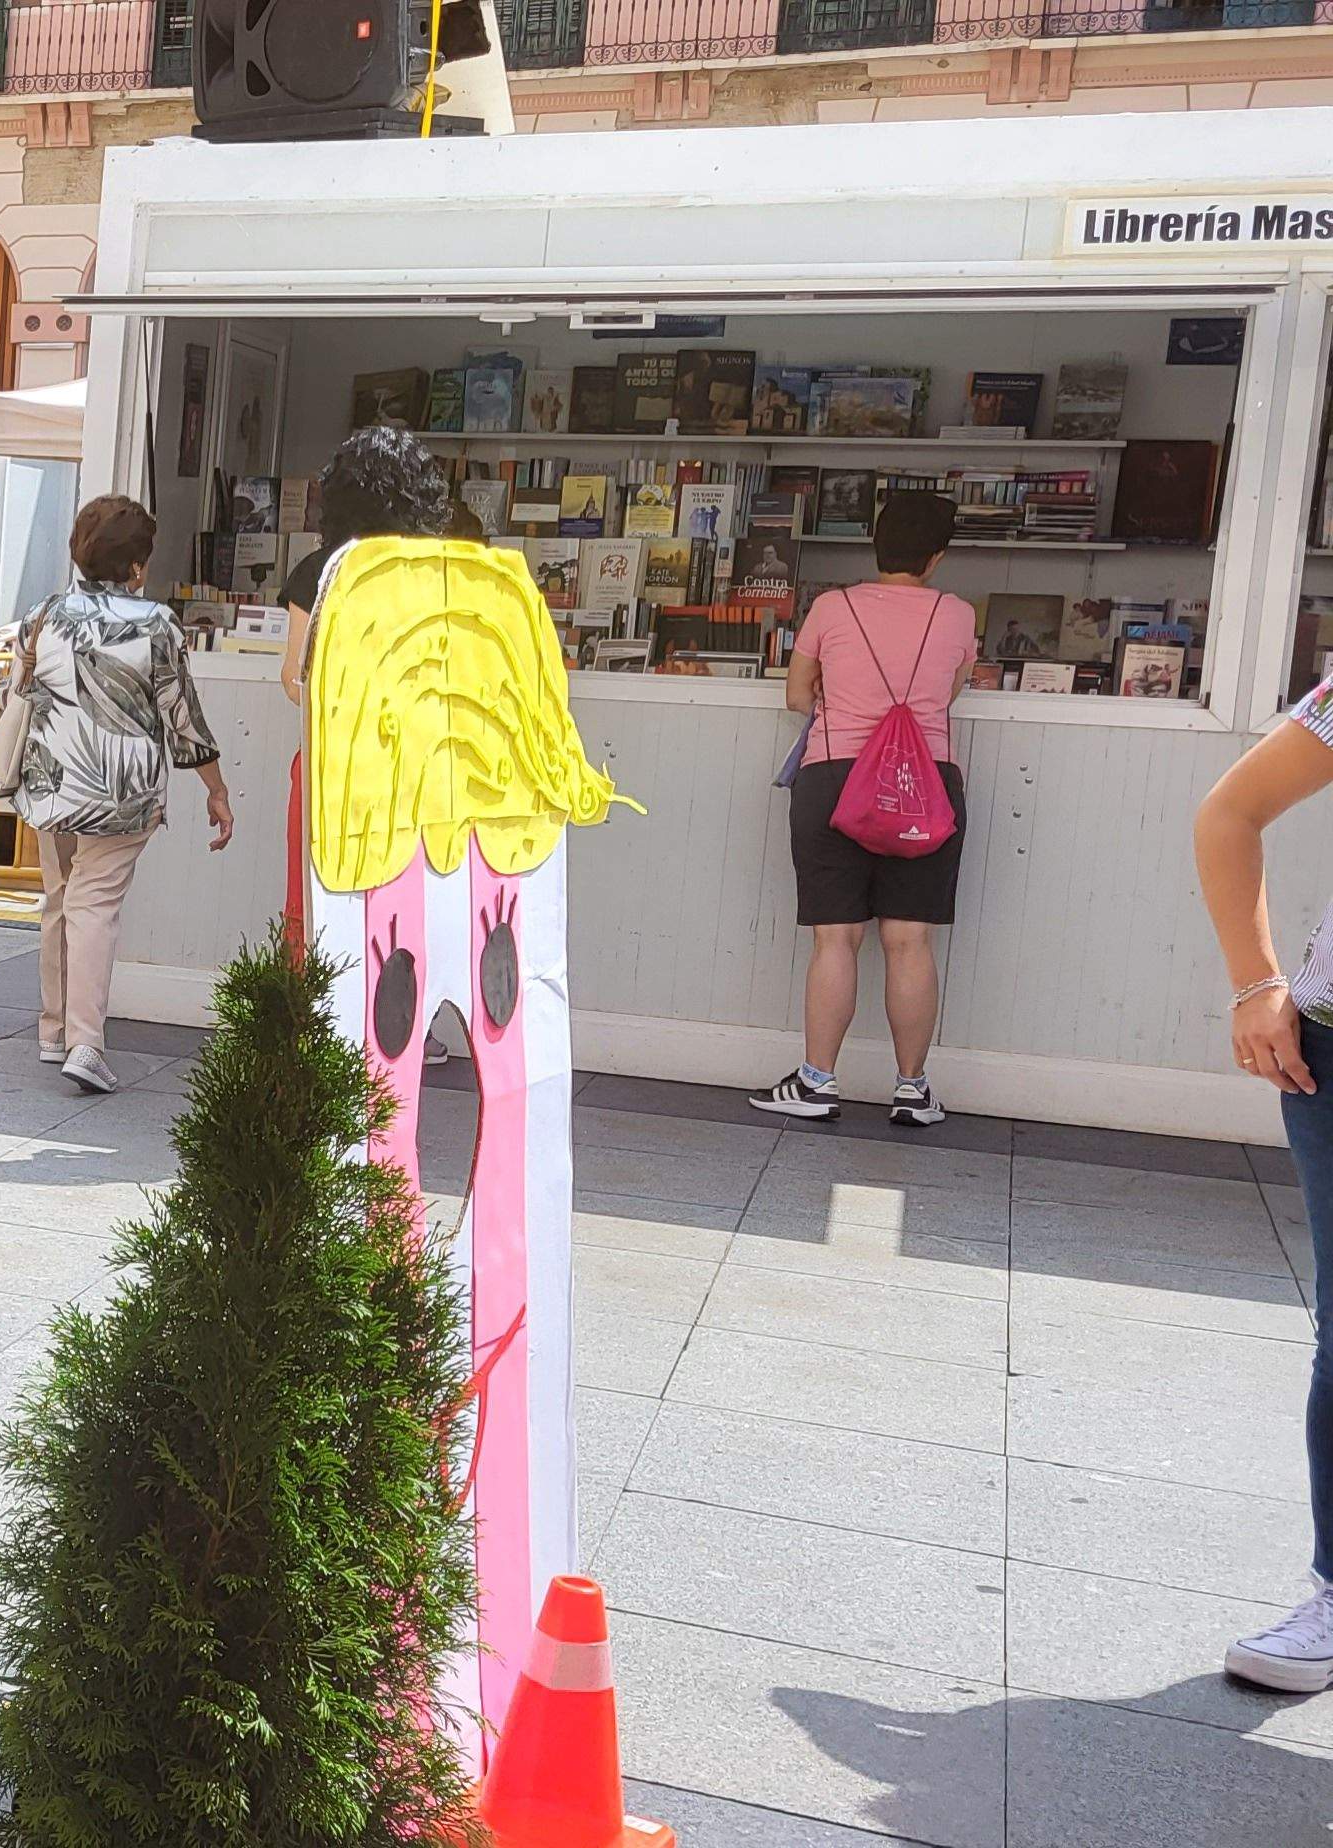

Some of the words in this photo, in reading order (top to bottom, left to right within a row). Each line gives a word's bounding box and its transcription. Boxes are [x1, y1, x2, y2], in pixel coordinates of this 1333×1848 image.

[1083, 204, 1241, 244] Librería
[1251, 204, 1333, 241] Mas
[626, 378, 658, 386] TODO
[744, 575, 788, 588] Contra
[737, 585, 788, 599] Corriente
